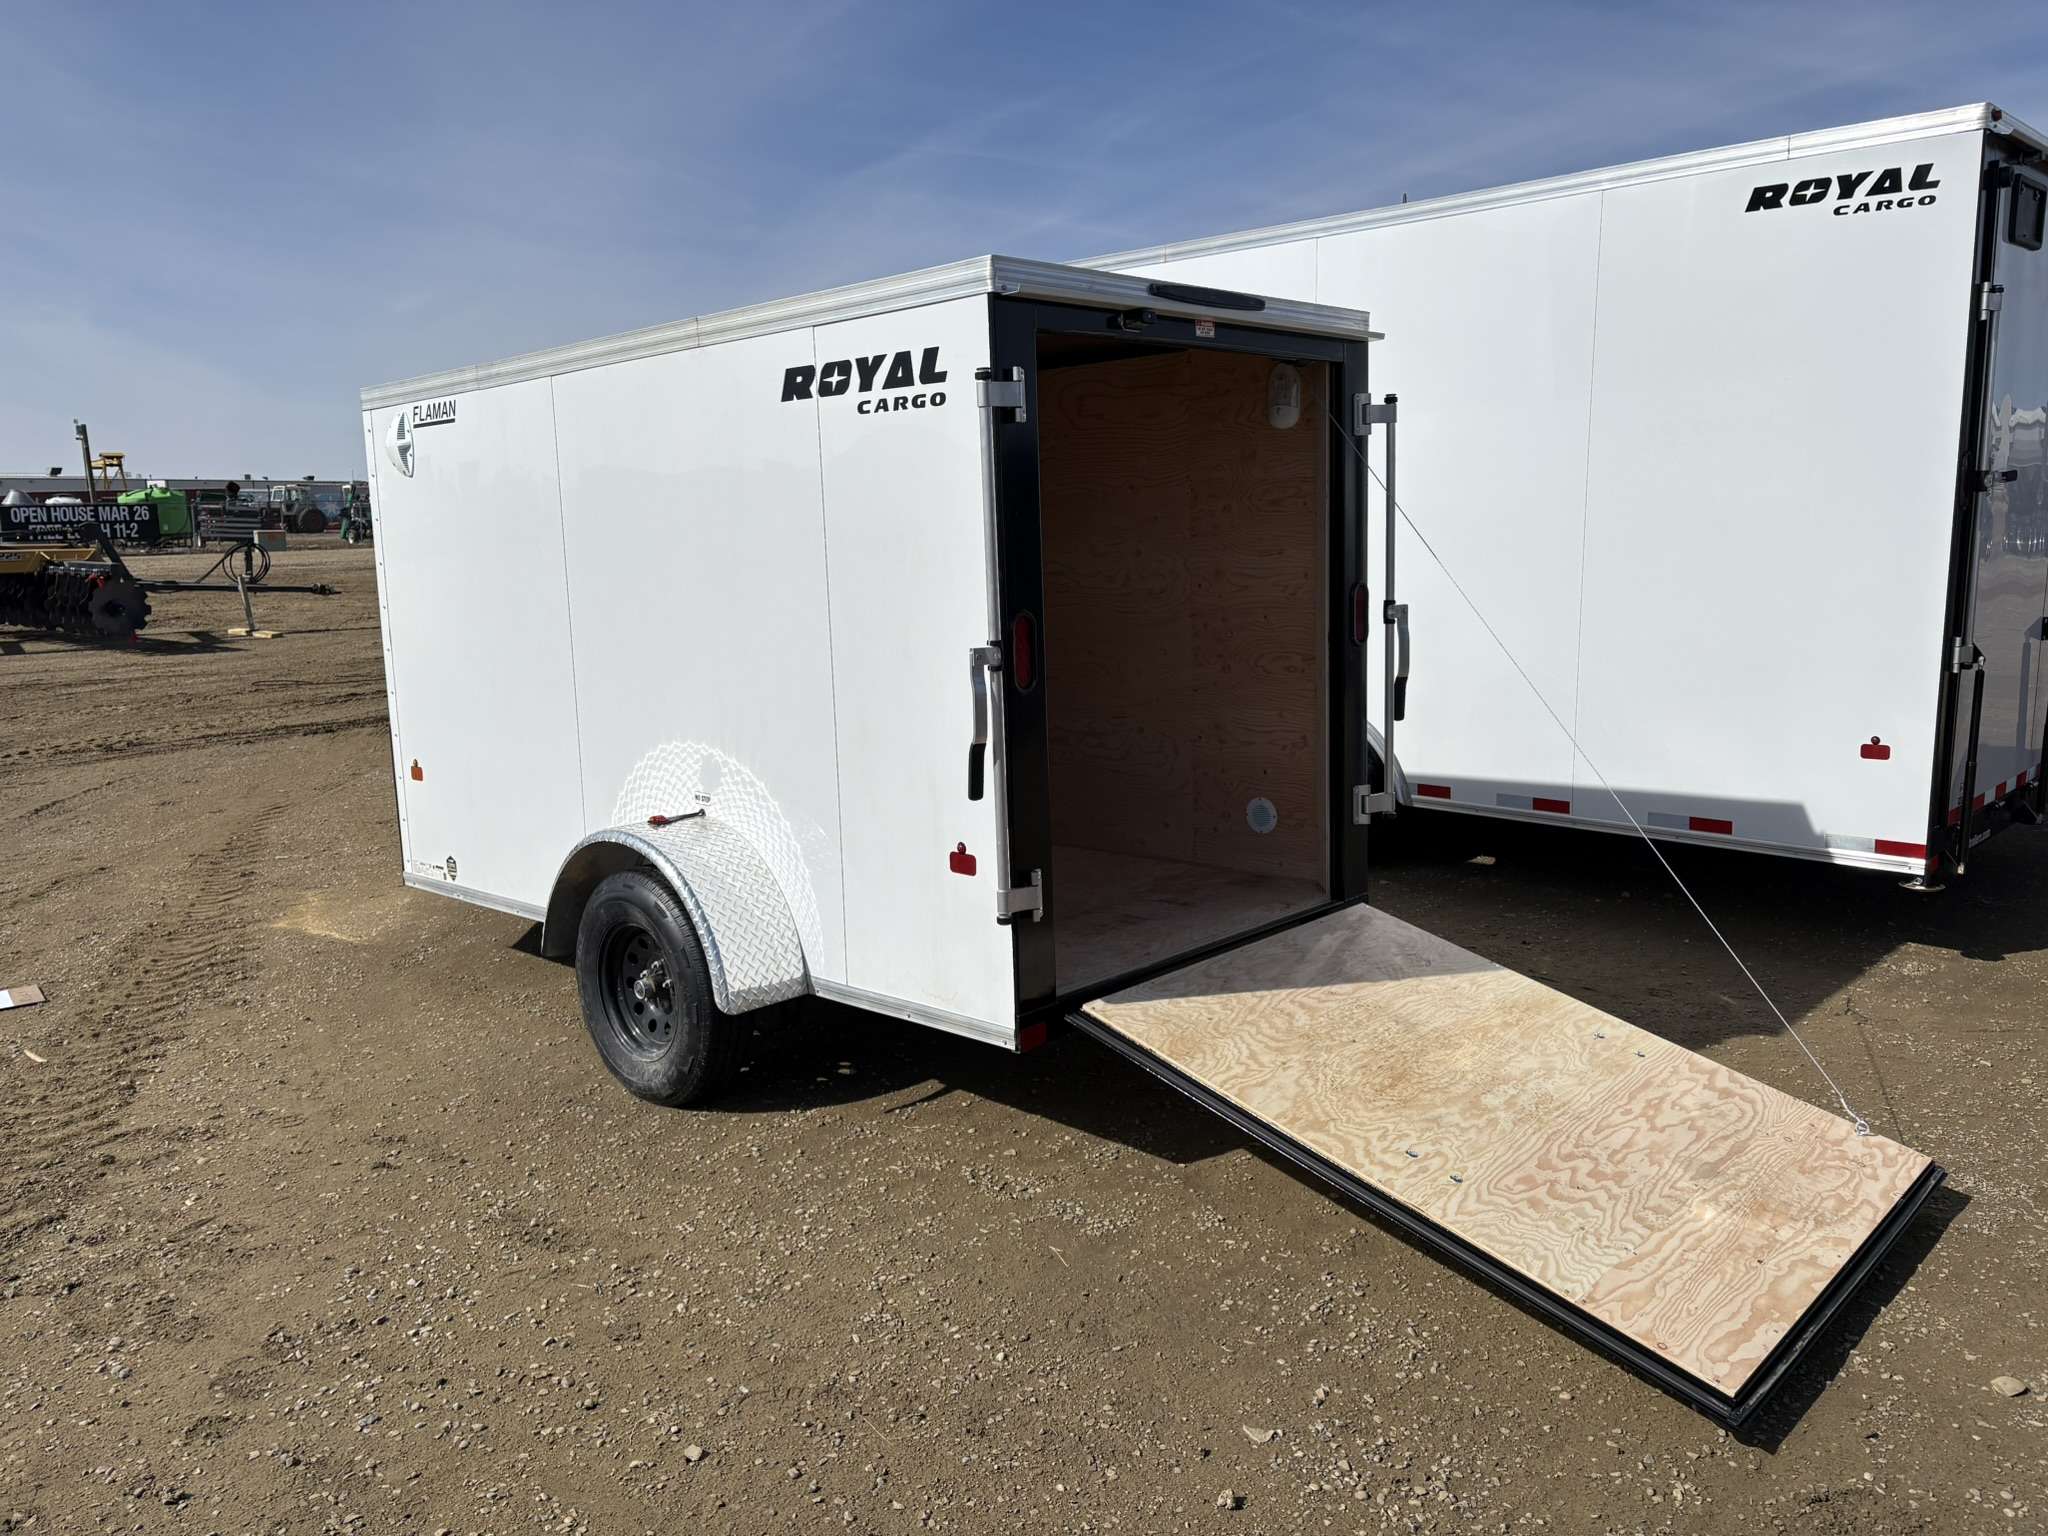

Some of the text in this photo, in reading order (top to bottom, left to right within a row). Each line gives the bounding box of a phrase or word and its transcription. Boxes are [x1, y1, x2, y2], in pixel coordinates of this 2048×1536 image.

[1745, 163, 1941, 213] ROYAL
[1833, 194, 1937, 216] CARGO
[781, 346, 948, 402] ROYAL
[413, 399, 456, 423] FLAMAN
[857, 392, 947, 415] CARGO
[10, 505, 150, 523] OPEN HOUSE MAR 26
[114, 522, 139, 538] 11-2
